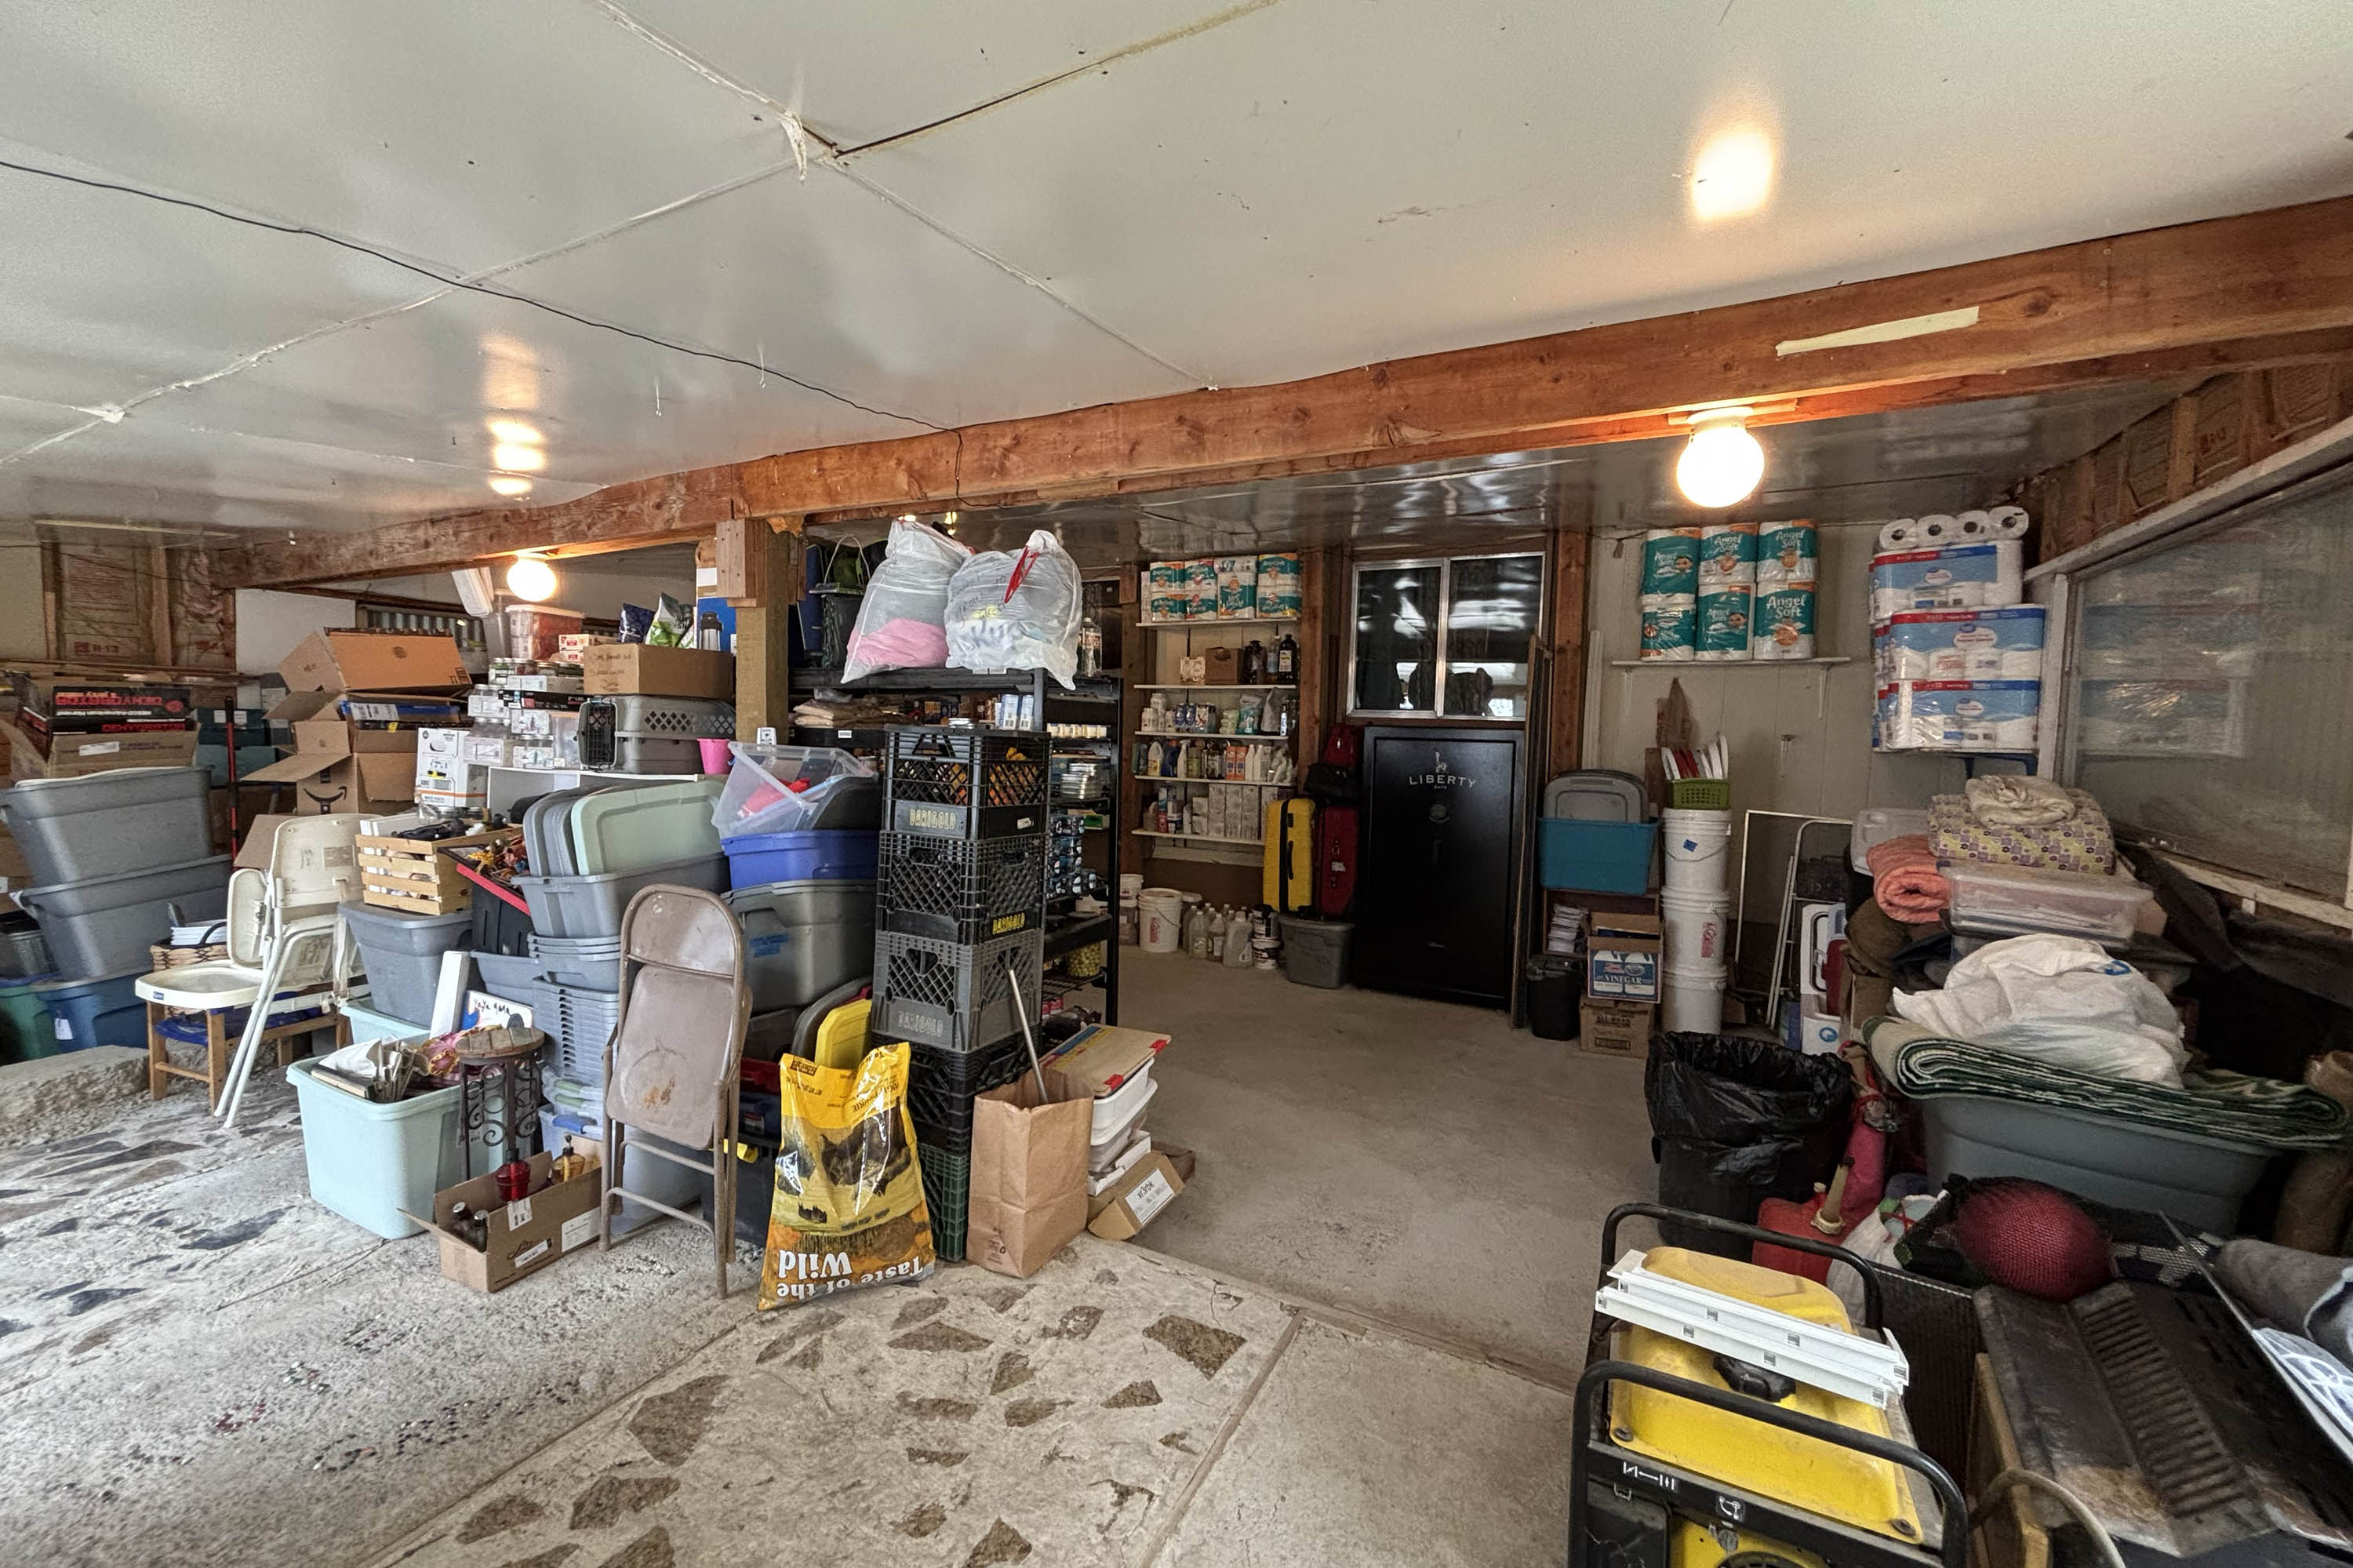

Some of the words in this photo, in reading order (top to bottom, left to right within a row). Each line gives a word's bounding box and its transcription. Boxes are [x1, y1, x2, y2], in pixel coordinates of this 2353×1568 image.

[1715, 534, 1742, 546] Angel
[1775, 529, 1806, 541] Angel
[1782, 539, 1802, 549] Soft
[1766, 595, 1807, 609] Angel
[1776, 606, 1802, 619] Soft
[1409, 774, 1476, 788] LIBERTY
[909, 809, 957, 830] DARIGOLD
[992, 912, 1026, 935] DARIGOLD
[1605, 974, 1643, 984] VINEGAR
[778, 1250, 853, 1280] Wild
[860, 1256, 923, 1284] Taste
[776, 1282, 816, 1301] the
[824, 1278, 851, 1294] of
